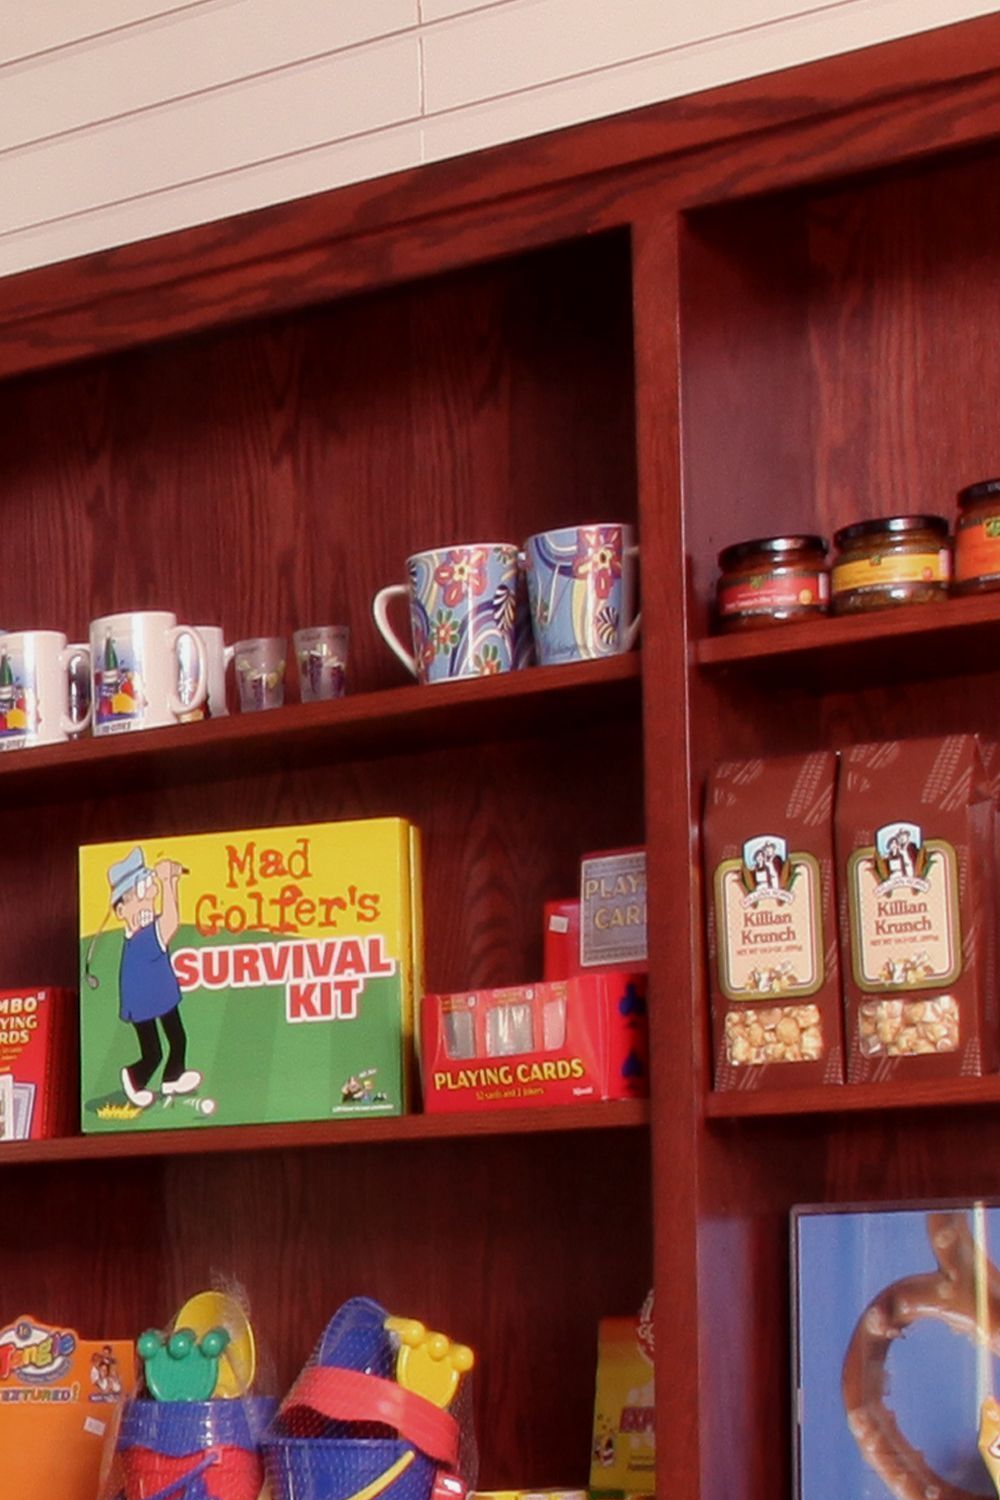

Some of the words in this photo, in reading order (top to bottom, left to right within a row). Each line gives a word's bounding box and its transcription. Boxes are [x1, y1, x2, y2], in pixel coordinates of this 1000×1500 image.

[224, 838, 313, 889] Mad
[585, 874, 640, 900] PLAY
[195, 884, 382, 937] Golfer's
[593, 904, 640, 930] CAR
[743, 910, 792, 928] Killian
[876, 899, 928, 917] Killian
[740, 926, 796, 945] Krunch
[874, 915, 933, 936] Krunch
[172, 936, 393, 989] SURVIVAL
[0, 996, 37, 1014] MBO
[287, 977, 361, 1020] KIT
[0, 1015, 37, 1031] YING
[0, 1030, 29, 1044] RDS
[434, 1065, 513, 1090] PLAYING
[517, 1058, 584, 1083] CARDS
